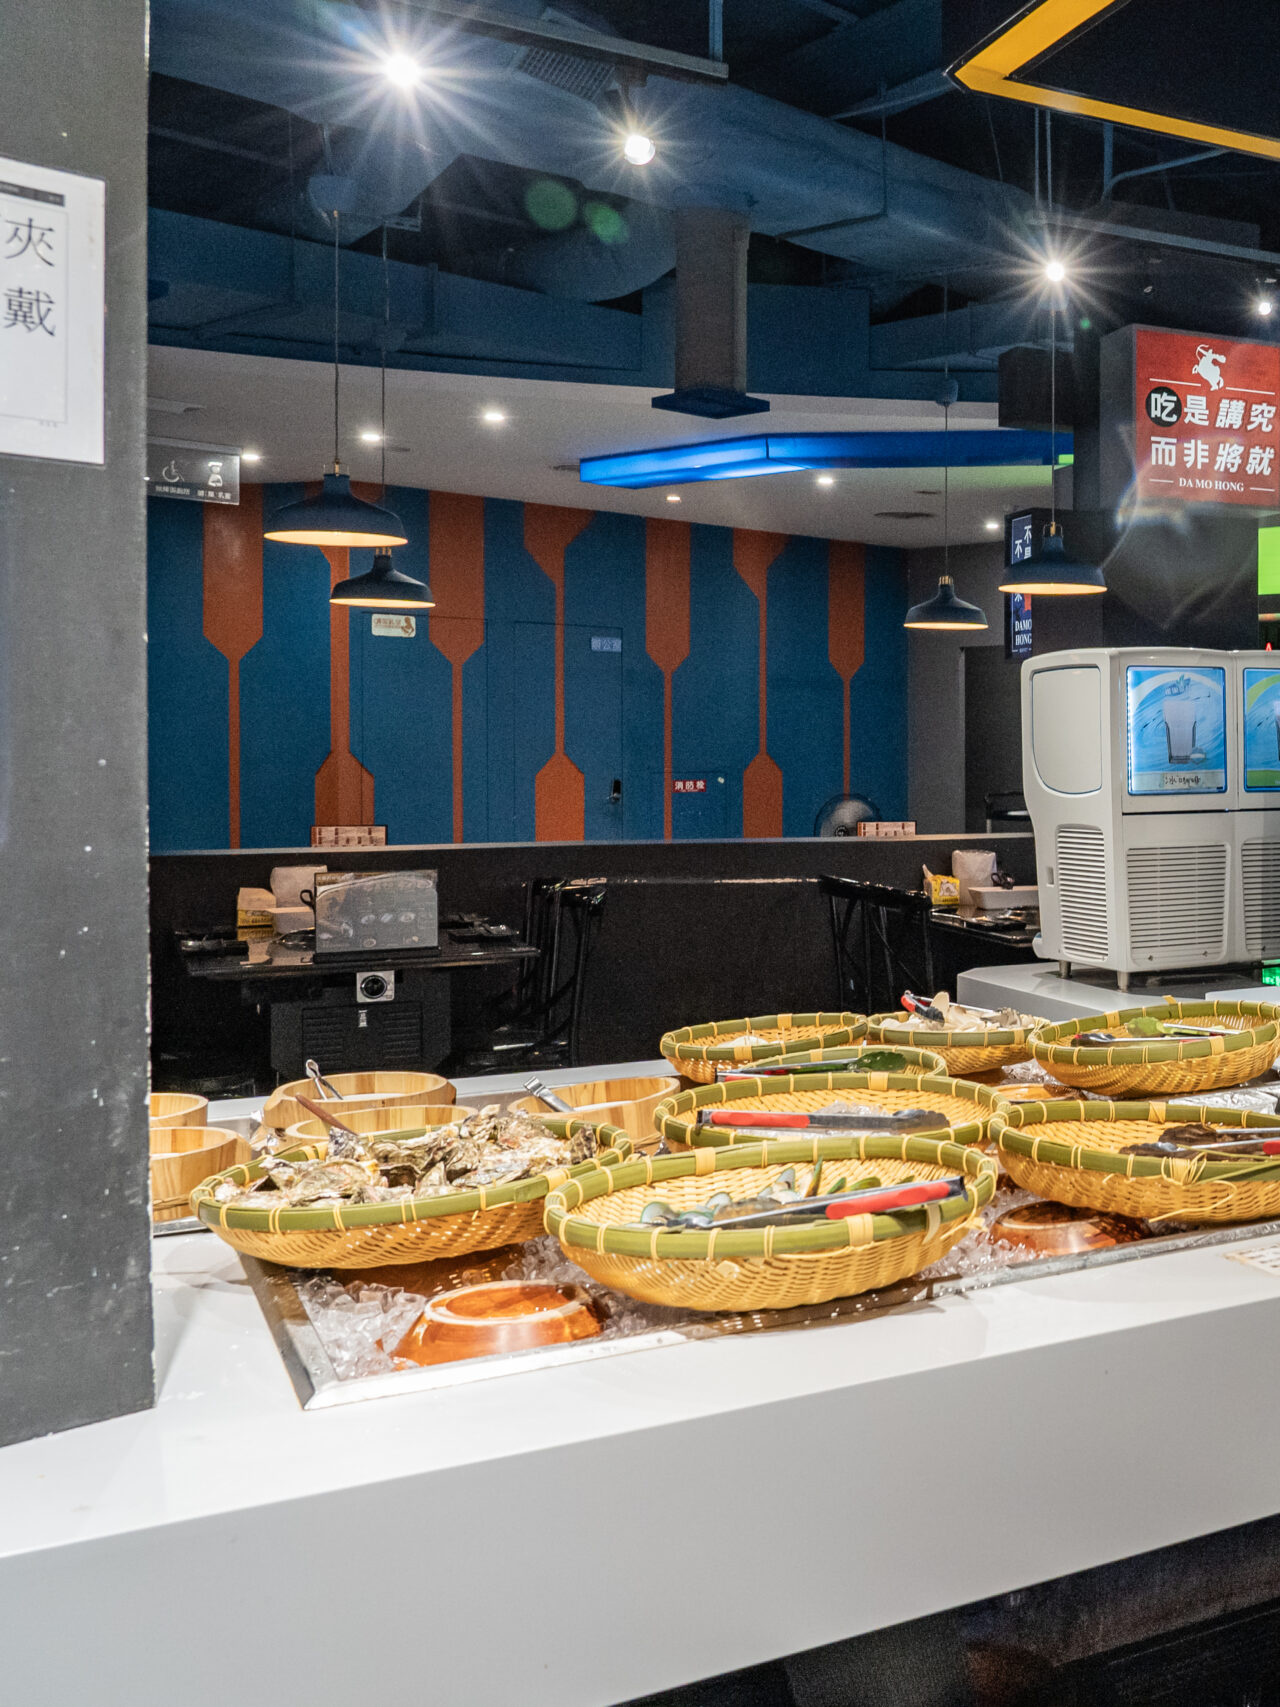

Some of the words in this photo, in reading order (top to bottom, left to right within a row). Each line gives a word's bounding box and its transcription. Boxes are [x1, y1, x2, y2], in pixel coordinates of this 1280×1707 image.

[1150, 391, 1277, 432] 吃是講究
[1150, 436, 1275, 475] 而非將就
[1179, 477, 1193, 487] DA
[1195, 479, 1213, 489] MO
[1214, 481, 1244, 492] HONG
[1015, 632, 1032, 646] HONG
[675, 780, 705, 790] 消防栓
